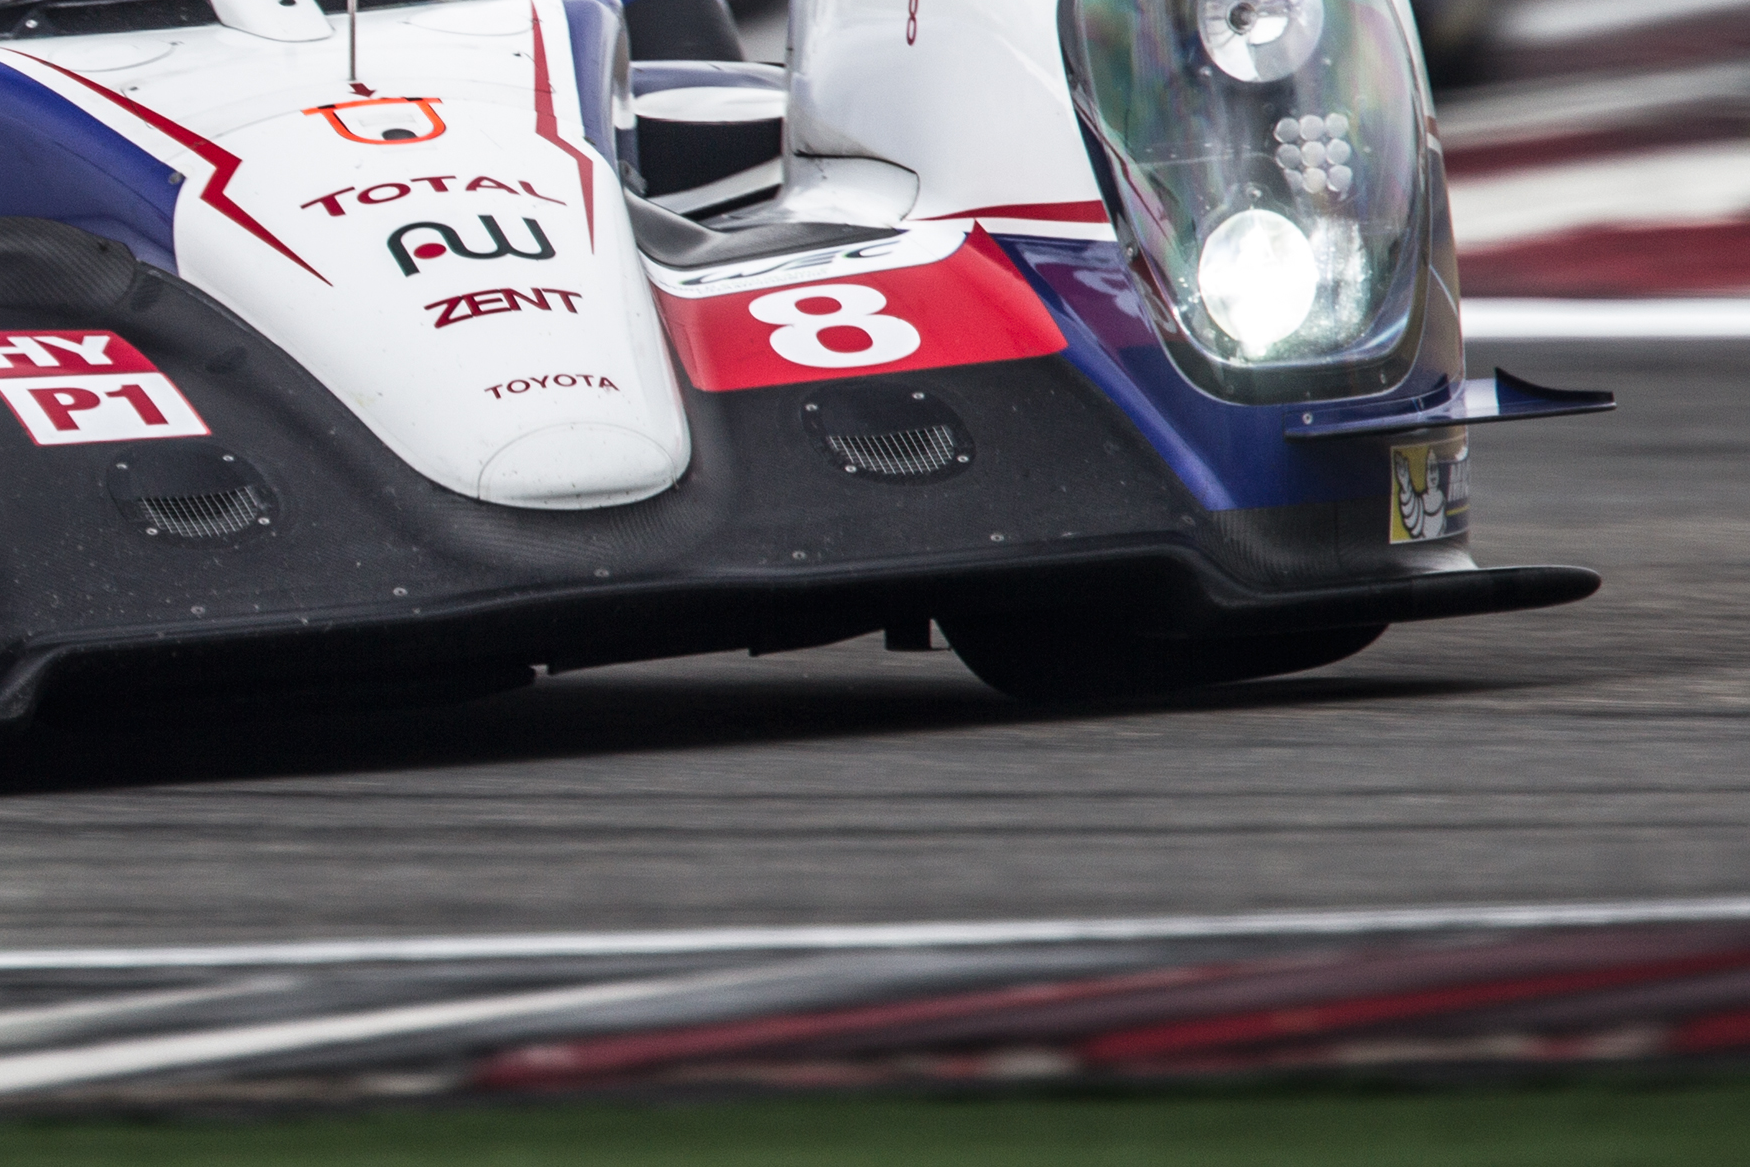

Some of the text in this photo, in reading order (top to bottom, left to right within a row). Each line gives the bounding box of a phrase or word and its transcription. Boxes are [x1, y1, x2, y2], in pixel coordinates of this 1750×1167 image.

[300, 174, 568, 217] TOTAL
[423, 287, 583, 329] ZENT
[748, 283, 922, 369] 8
[28, 384, 169, 432] P1
[483, 373, 620, 401] TOYOTA
